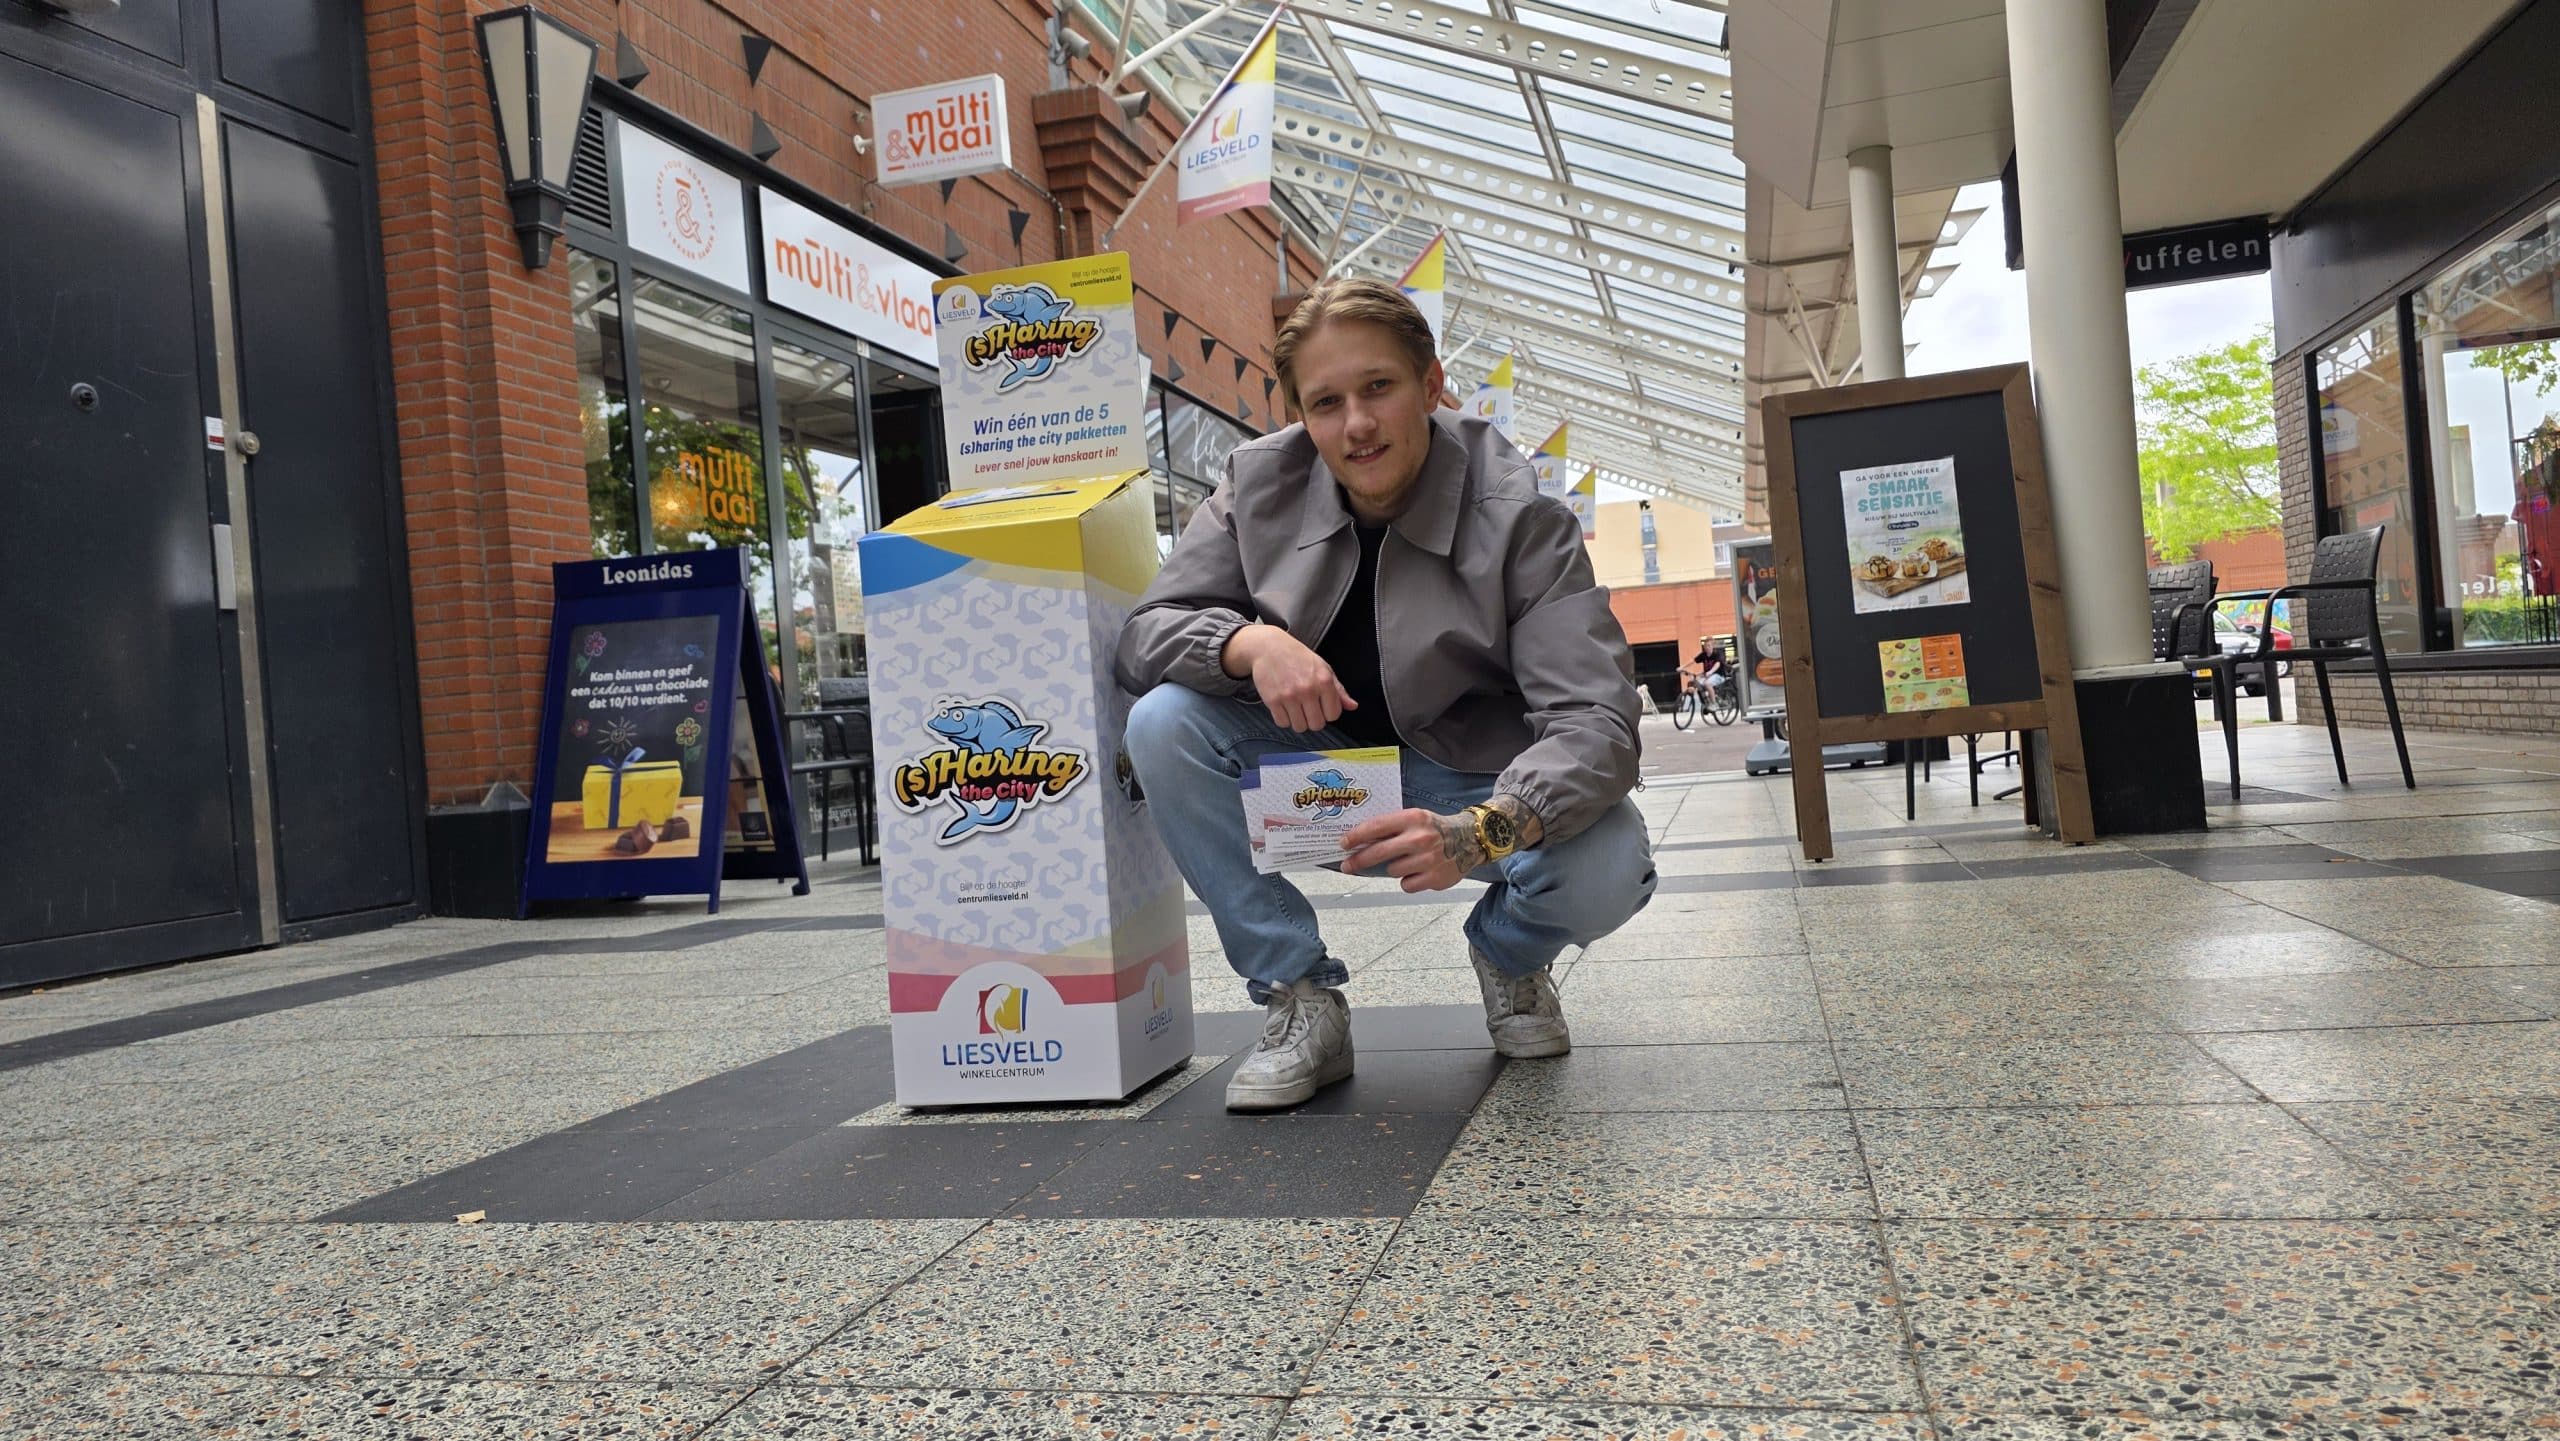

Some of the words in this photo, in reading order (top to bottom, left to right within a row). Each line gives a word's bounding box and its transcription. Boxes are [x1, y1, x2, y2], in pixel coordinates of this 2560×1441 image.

[1187, 134, 1260, 169] LIESVELD
[943, 308, 976, 319] LIESVELD
[965, 320, 1099, 367] (s)Haring
[1011, 346, 1036, 360] the
[1037, 342, 1067, 358] City
[974, 417, 1003, 435] Win
[1008, 412, 1036, 431] één
[1041, 410, 1070, 427] van
[1075, 405, 1094, 422] de
[1099, 403, 1109, 419] 5
[960, 438, 1014, 456] (s)haring
[1017, 435, 1040, 448] the
[1039, 431, 1062, 446] city
[1065, 424, 1127, 445] pakketten
[975, 463, 1001, 474] Lever
[1003, 457, 1025, 470] snel
[1026, 456, 1050, 470] jouw
[1052, 449, 1103, 464] kanskaart
[1105, 446, 1119, 458] in!
[1911, 466, 1940, 475] UNIEKE
[1868, 476, 1930, 496] SMAAK
[1857, 490, 1944, 513] SENSATIE
[602, 560, 693, 585] Leonidas
[590, 672, 614, 682] Kom
[615, 669, 651, 680] binnen
[652, 668, 666, 678] en
[667, 664, 694, 678] geef
[570, 687, 591, 697] een
[592, 682, 633, 696] cadeau
[634, 683, 654, 692] van
[655, 677, 709, 691] chocolade
[588, 697, 607, 709] dat
[610, 695, 639, 709] 10/10
[640, 692, 688, 705] verdient.
[896, 748, 1082, 804] (s)Haring
[960, 784, 995, 801] the
[996, 780, 1038, 801] City
[1293, 786, 1368, 808] (s)Haring
[957, 891, 1029, 904] centrumliesveld.nl
[1144, 1007, 1174, 1035] LIESVELD
[942, 1039, 1063, 1066] LIESVELD
[960, 1067, 1046, 1080] WINKELCENTRUM
